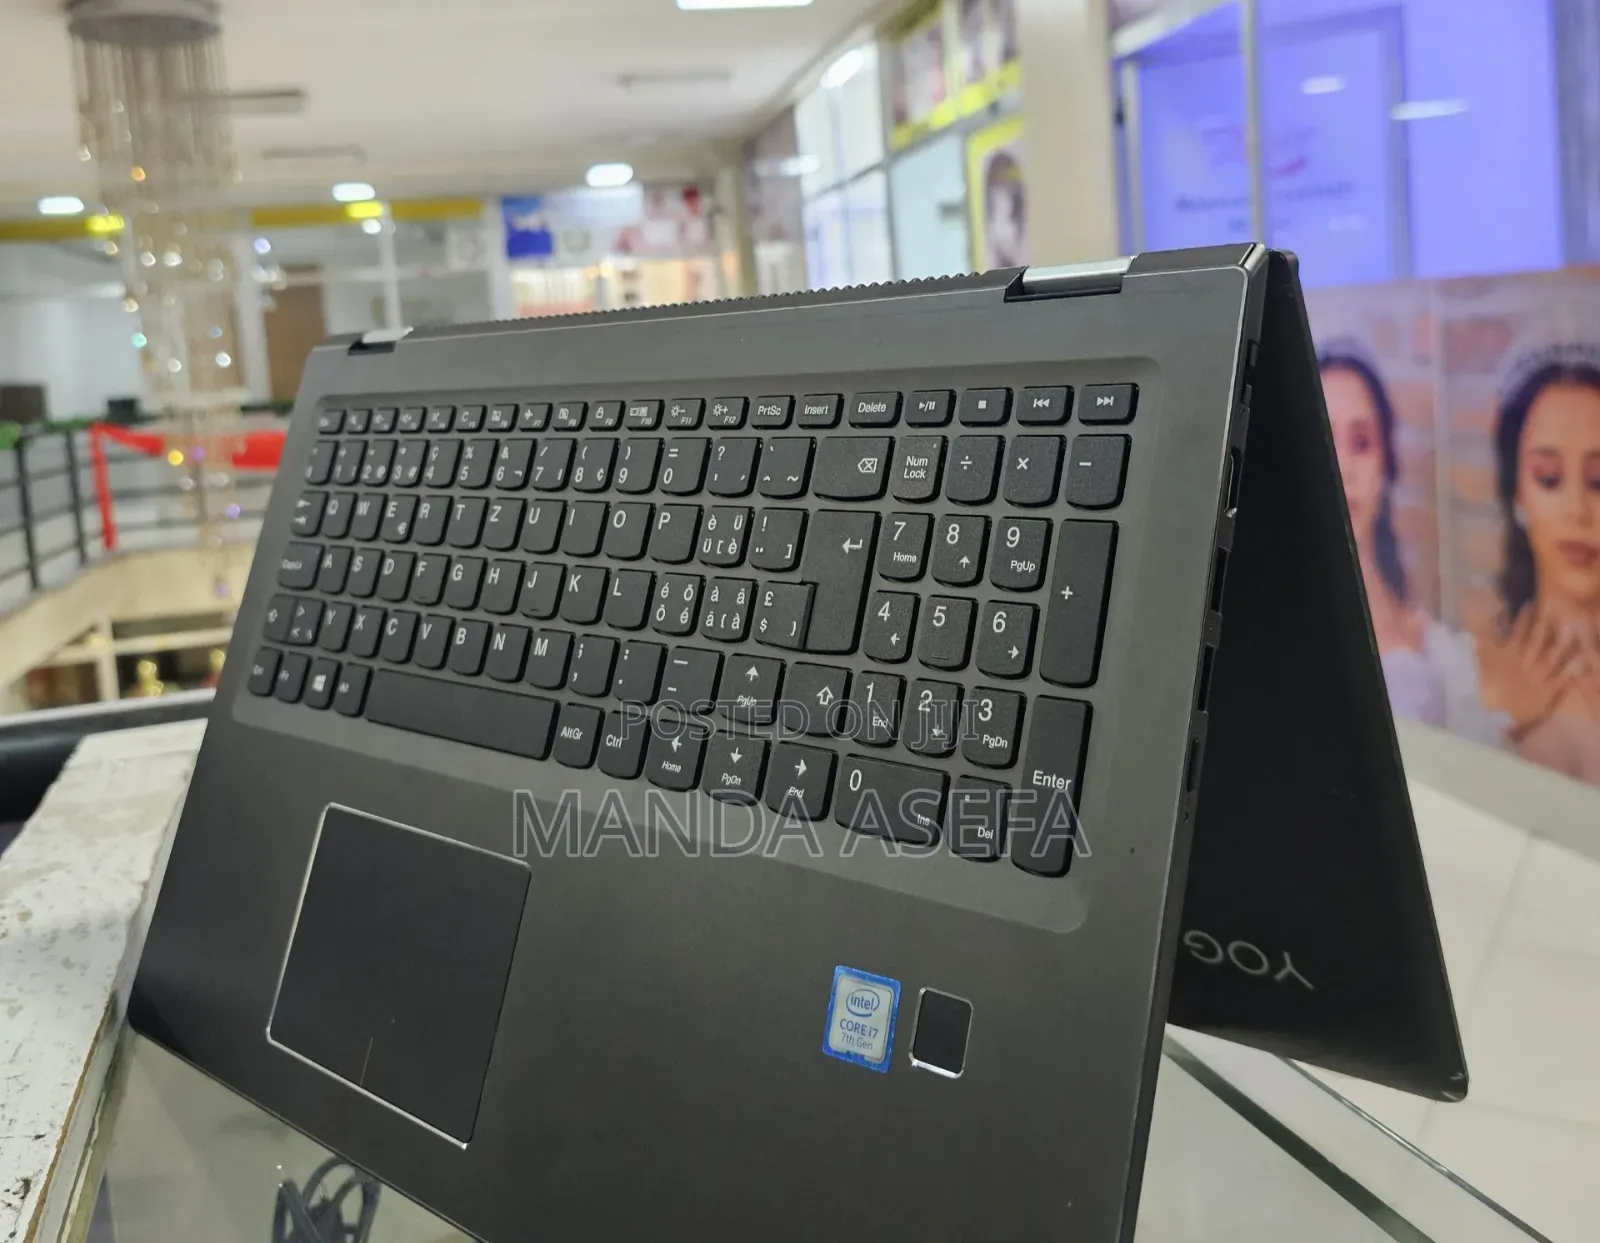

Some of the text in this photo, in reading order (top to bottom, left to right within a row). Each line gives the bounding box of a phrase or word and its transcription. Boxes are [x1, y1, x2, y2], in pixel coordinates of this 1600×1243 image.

[757, 405, 782, 417] PrtSc
[804, 403, 829, 416] Insert
[857, 401, 887, 415] Delete
[680, 416, 693, 425] F11
[723, 415, 737, 424] F12
[501, 445, 509, 460] &
[668, 448, 679, 458] =
[717, 445, 726, 461] ?
[905, 455, 928, 467] Num
[460, 466, 469, 481] 5
[496, 466, 505, 481] 6
[535, 466, 544, 482] 7
[574, 466, 584, 483] 8
[618, 467, 629, 484] 9
[663, 467, 673, 485] 0
[903, 467, 926, 480] Lock
[357, 501, 371, 516] W
[386, 501, 398, 518] E
[418, 503, 430, 519] R
[455, 504, 466, 521] T
[490, 505, 502, 522] Z
[528, 507, 541, 525] U
[613, 510, 627, 528] O
[658, 512, 671, 530] P
[893, 521, 906, 541] 7
[946, 523, 960, 545] 8
[1005, 526, 1021, 548] 9
[324, 550, 333, 569] A
[352, 556, 364, 572] S
[893, 552, 917, 563] Home
[383, 558, 395, 575] D
[416, 561, 427, 577] F
[452, 564, 463, 581] G
[1010, 560, 1036, 573] PgUp
[487, 568, 500, 585] H
[528, 571, 538, 588] J
[568, 574, 582, 592] K
[613, 578, 622, 597] L
[763, 591, 774, 607] £
[877, 601, 891, 622] 4
[932, 606, 947, 627] 5
[355, 615, 367, 630] X
[386, 618, 398, 636] C
[759, 618, 768, 633] $
[992, 612, 1007, 634] 6
[422, 623, 433, 640] V
[455, 627, 467, 645] B
[494, 633, 506, 651] N
[534, 638, 549, 657] M
[737, 695, 757, 707] PgUp
[865, 682, 875, 703] 1
[918, 689, 934, 711] 2
[978, 699, 993, 721] 3
[872, 716, 889, 729] End
[560, 726, 583, 741] AltGr
[605, 734, 623, 749] Ctrl
[982, 734, 1008, 749] PgDn
[661, 760, 682, 773] Home
[721, 772, 742, 787] PgDn
[849, 769, 863, 791] 0
[1032, 769, 1072, 791] Enter
[787, 786, 805, 799] End
[916, 813, 931, 827] Ins
[977, 826, 994, 841] Del
[850, 992, 875, 1011] intel
[839, 1018, 879, 1040] CORE i7
[841, 1031, 873, 1051] 7th Gen
